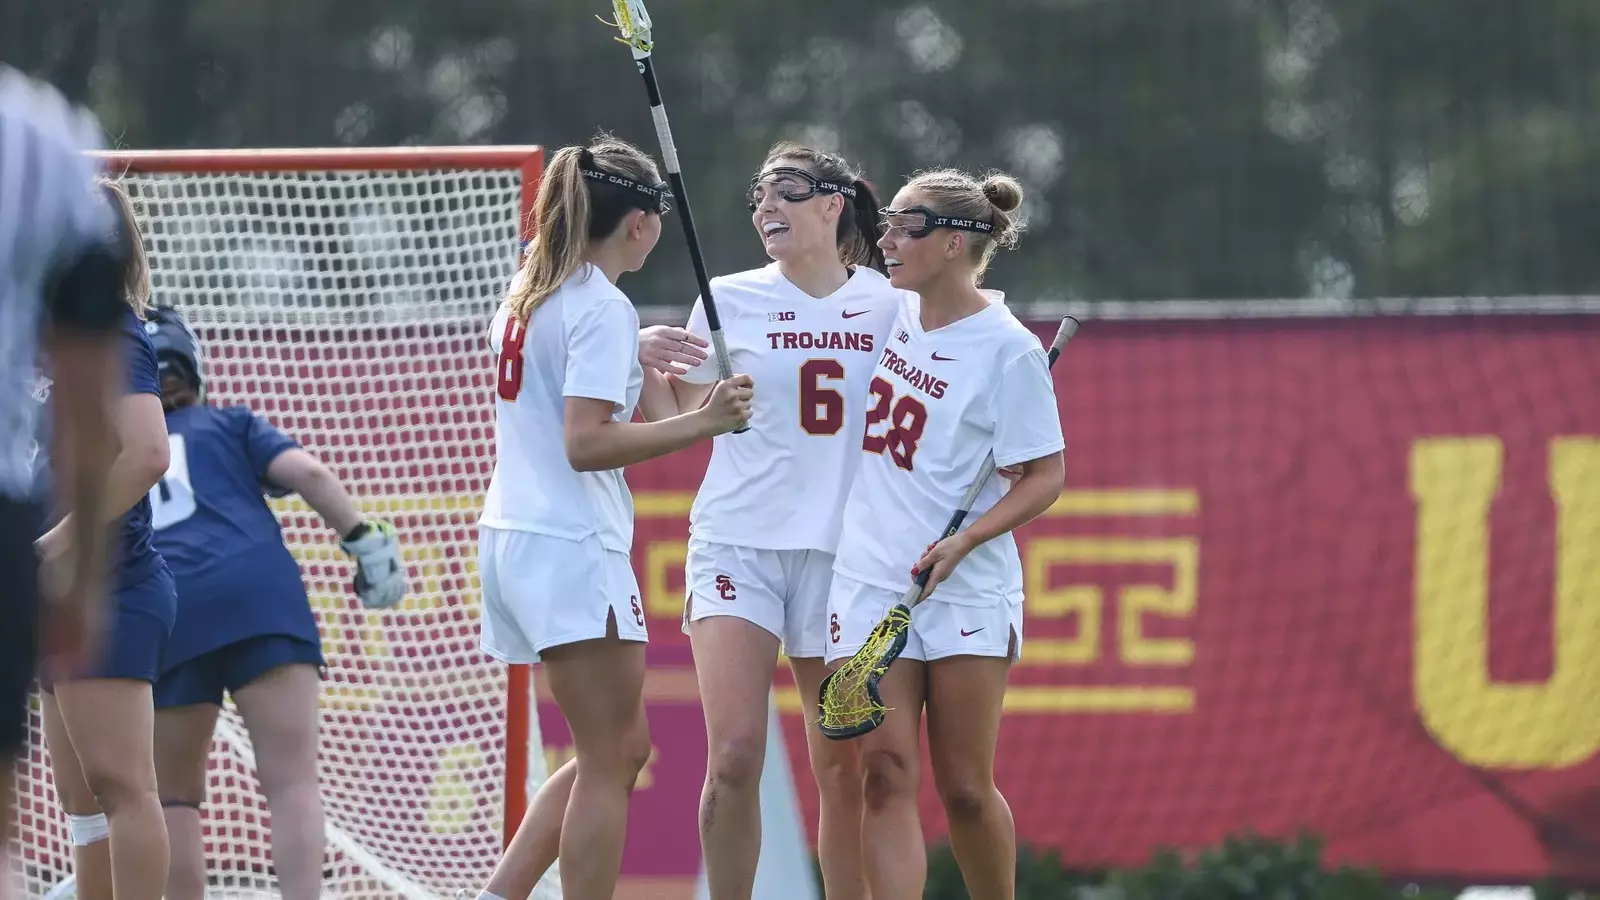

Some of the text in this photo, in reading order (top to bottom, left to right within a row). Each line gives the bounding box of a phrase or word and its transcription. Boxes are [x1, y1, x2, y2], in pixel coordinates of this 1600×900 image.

[581, 168, 658, 196] GAIT GAIT GAIT
[820, 182, 838, 191] GAIT
[951, 219, 974, 228] GAIT
[975, 221, 992, 231] GAIT
[766, 331, 874, 353] TROJANS
[879, 347, 949, 400] TROJANS
[798, 357, 845, 437] 6
[861, 374, 928, 473] 28
[715, 574, 737, 601] SC
